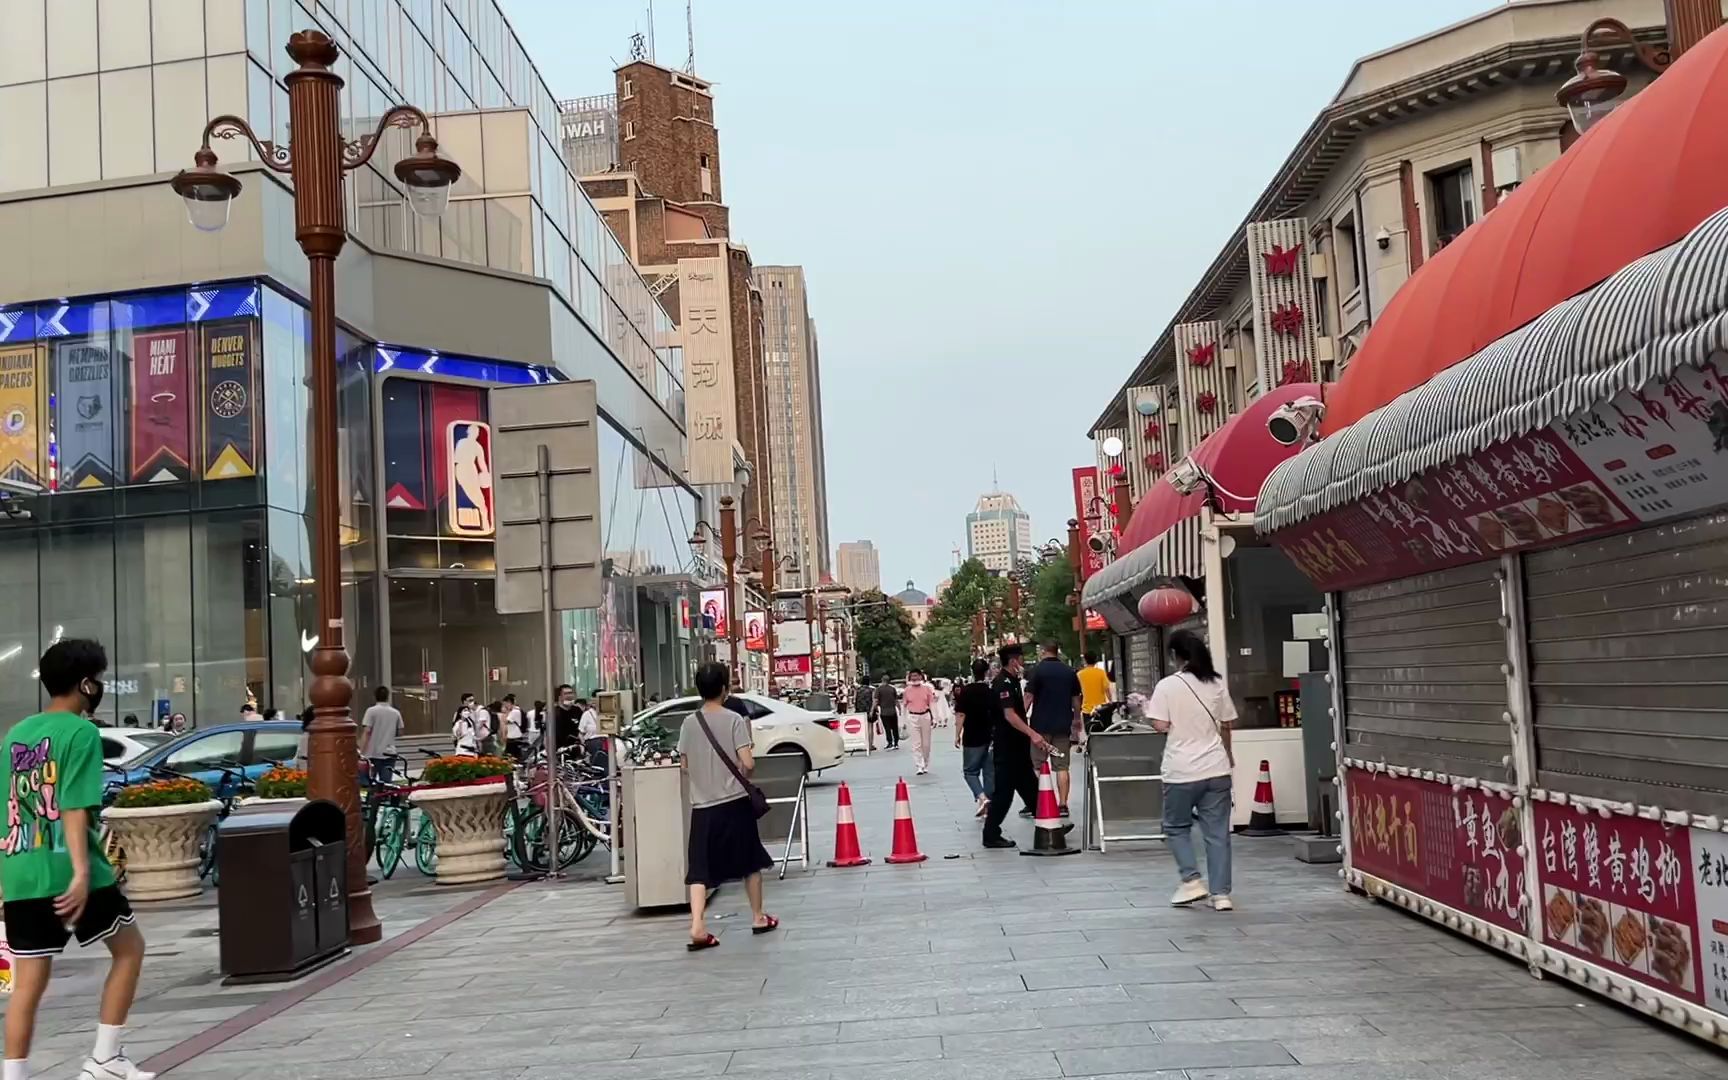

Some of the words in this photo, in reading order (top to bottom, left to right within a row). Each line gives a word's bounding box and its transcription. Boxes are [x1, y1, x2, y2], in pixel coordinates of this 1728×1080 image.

[150, 339, 177, 357] MIAMI
[211, 335, 244, 354] DENVER
[149, 355, 176, 376] HEAT
[1351, 780, 1418, 868] 武汉热干面
